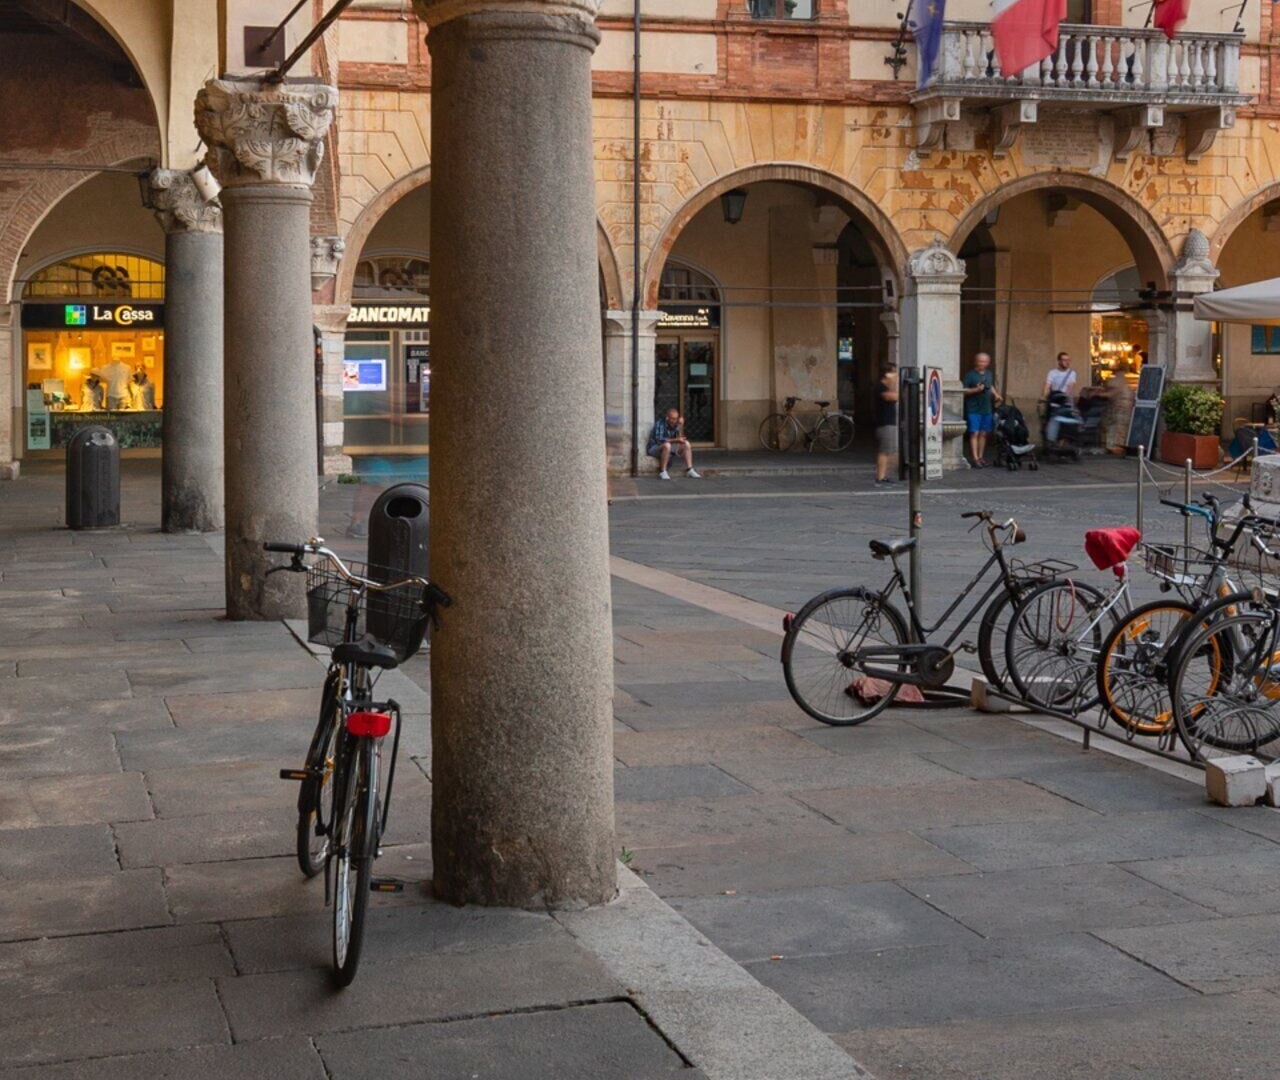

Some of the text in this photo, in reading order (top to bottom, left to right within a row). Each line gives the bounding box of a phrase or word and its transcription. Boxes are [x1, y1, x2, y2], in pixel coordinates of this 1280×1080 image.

[93, 305, 154, 325] La Cassa
[347, 307, 431, 322] BANCOMAT
